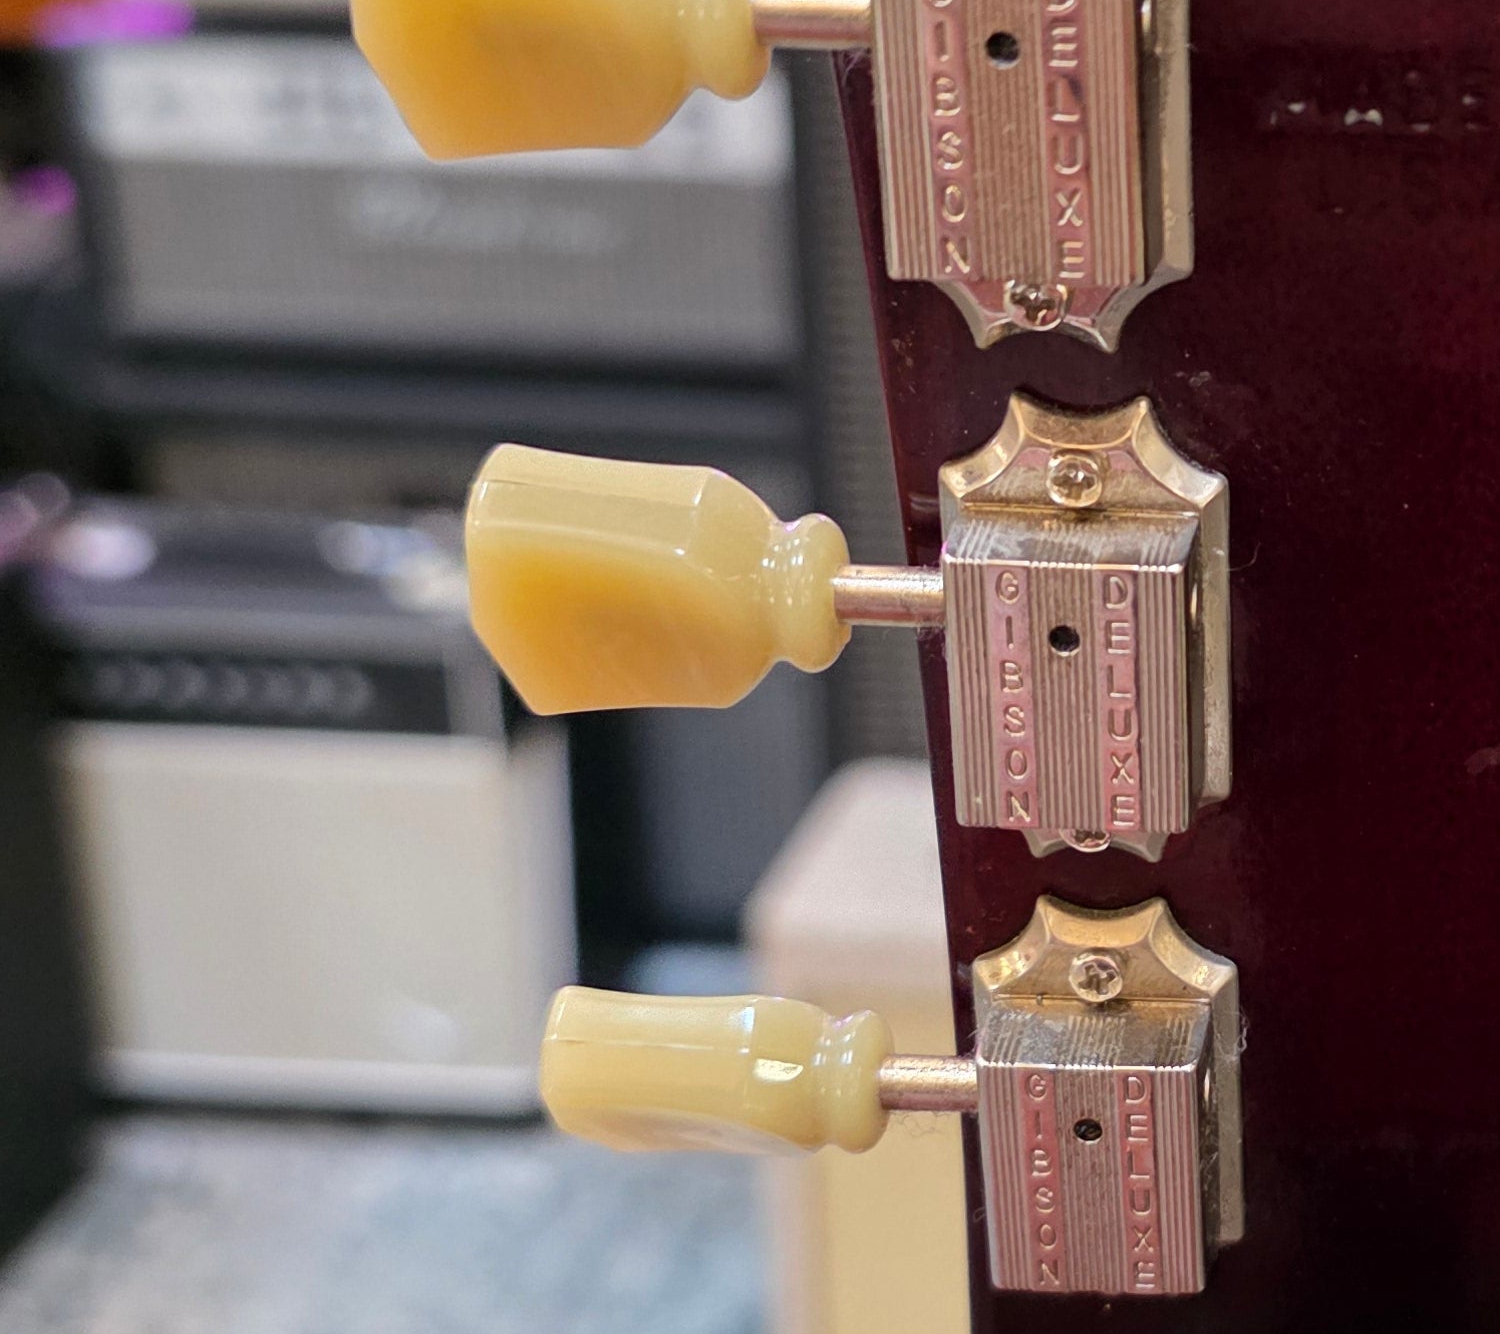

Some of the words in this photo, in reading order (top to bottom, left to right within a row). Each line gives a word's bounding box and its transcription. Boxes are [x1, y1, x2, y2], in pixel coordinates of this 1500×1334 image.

[995, 571, 1031, 823] GIBSON
[1104, 575, 1135, 827] DELUXE
[1026, 1074, 1060, 1286] GIBSON
[1124, 1075, 1155, 1289] DELUXE
